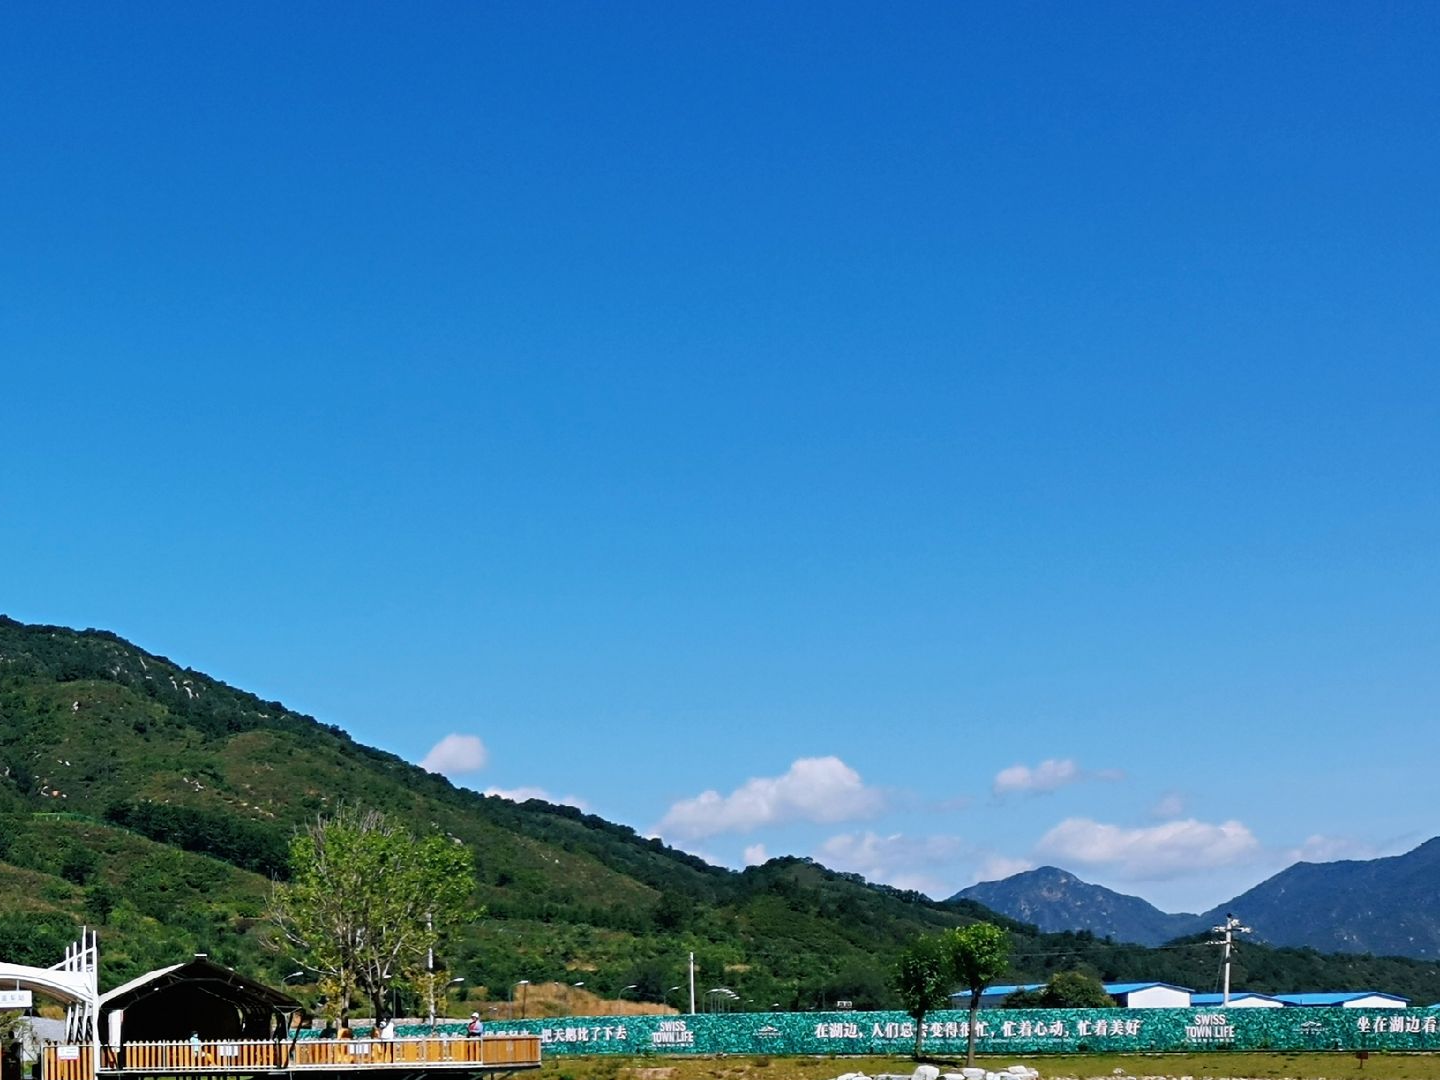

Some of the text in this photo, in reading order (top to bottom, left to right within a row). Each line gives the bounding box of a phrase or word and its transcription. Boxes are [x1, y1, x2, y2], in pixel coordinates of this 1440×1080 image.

[660, 1020, 686, 1032] SWISS
[1194, 1014, 1226, 1026] SWISS
[1357, 1015, 1437, 1034] 坐在湖边看
[652, 1031, 694, 1043] TOWN LIFE
[1185, 1025, 1235, 1038] TOWN LIFE
